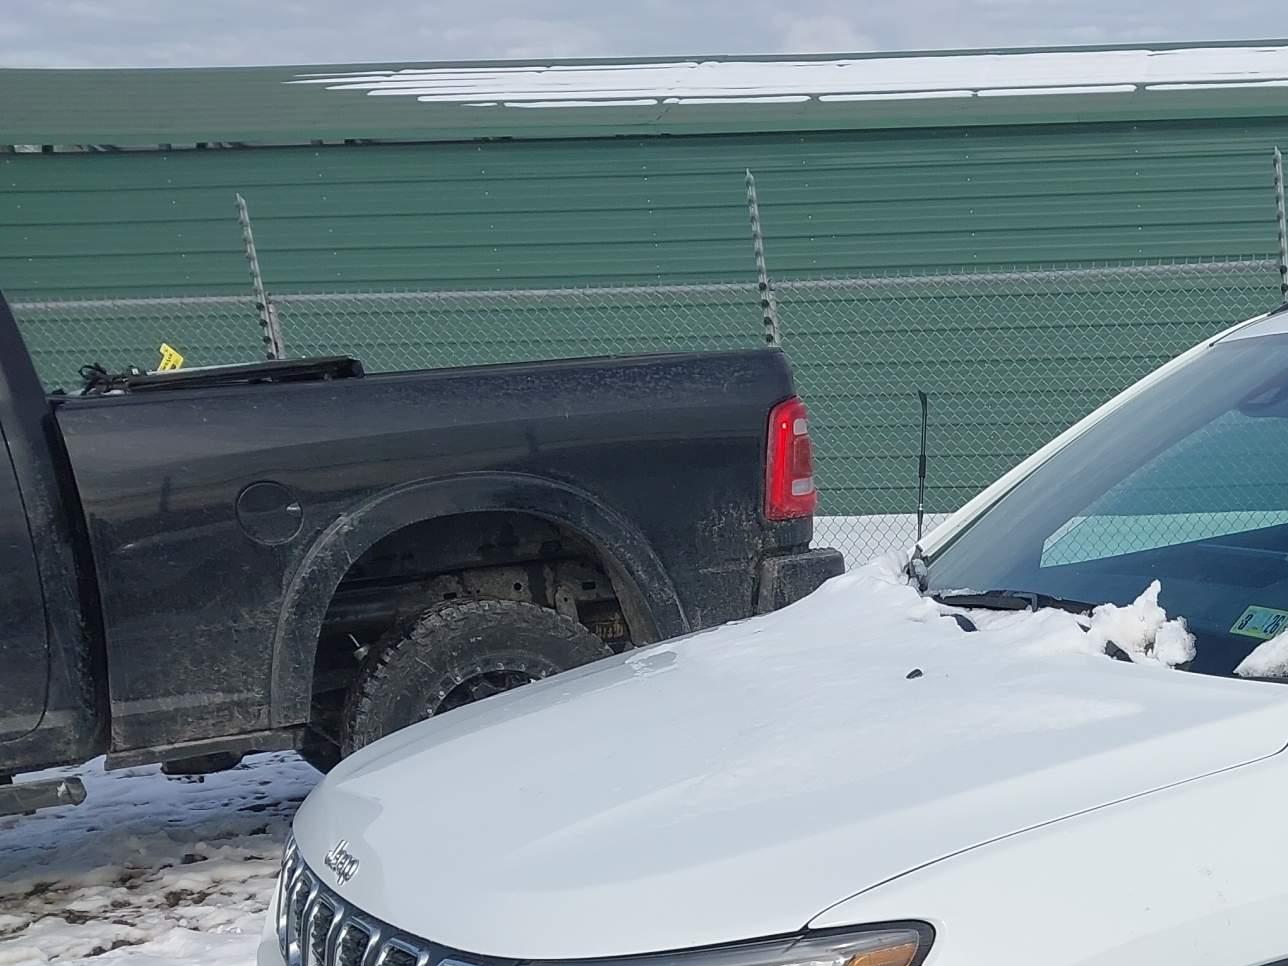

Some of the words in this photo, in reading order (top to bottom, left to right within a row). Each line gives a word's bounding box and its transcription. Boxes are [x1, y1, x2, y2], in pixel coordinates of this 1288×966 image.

[1238, 614, 1254, 630] 3
[1264, 614, 1286, 634] 26
[324, 839, 360, 886] Jeep
